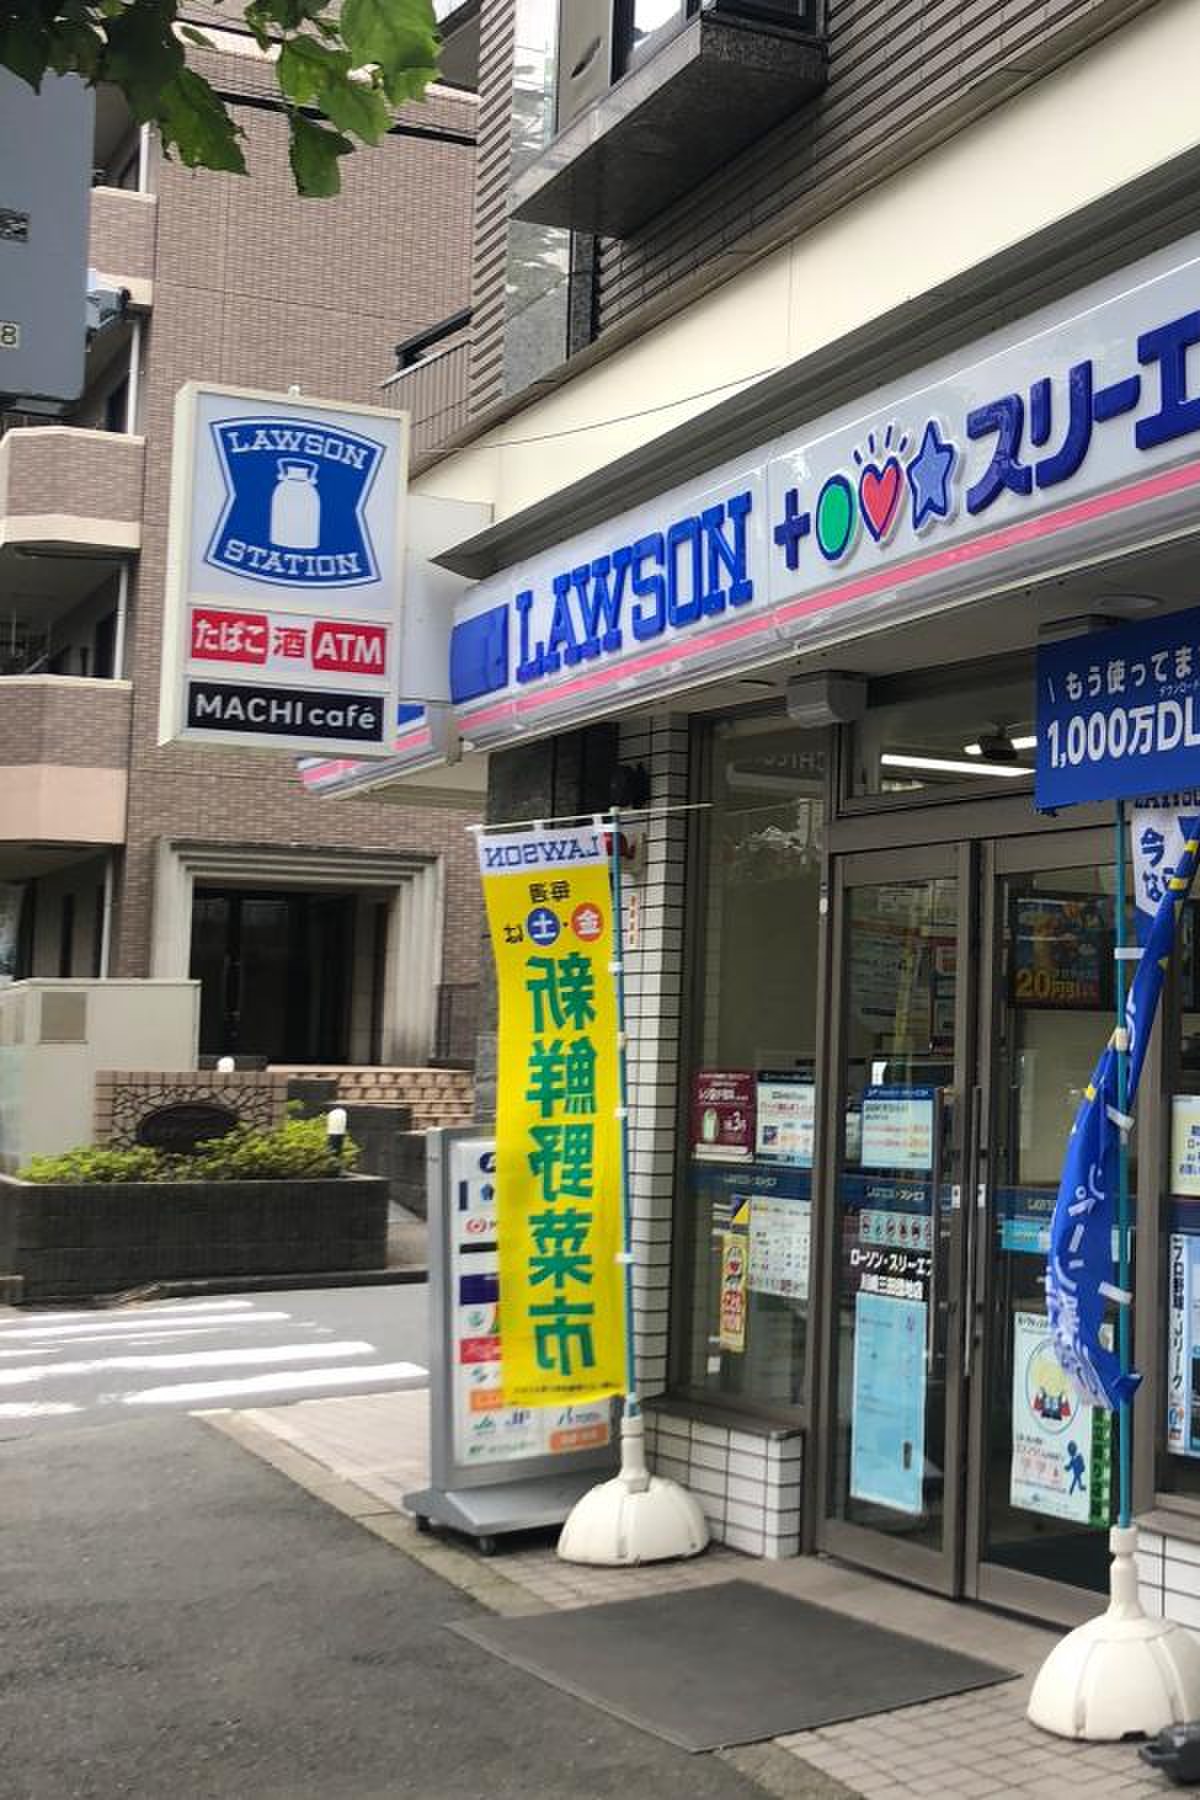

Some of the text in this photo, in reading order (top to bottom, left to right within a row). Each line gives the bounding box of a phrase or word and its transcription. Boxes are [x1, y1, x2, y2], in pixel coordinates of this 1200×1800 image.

[228, 430, 368, 470] LAWSON
[224, 539, 358, 576] STATION
[515, 491, 753, 682] LAWSON
[194, 618, 384, 666] たばこ 酒 ATM
[195, 694, 376, 730] MACHI café
